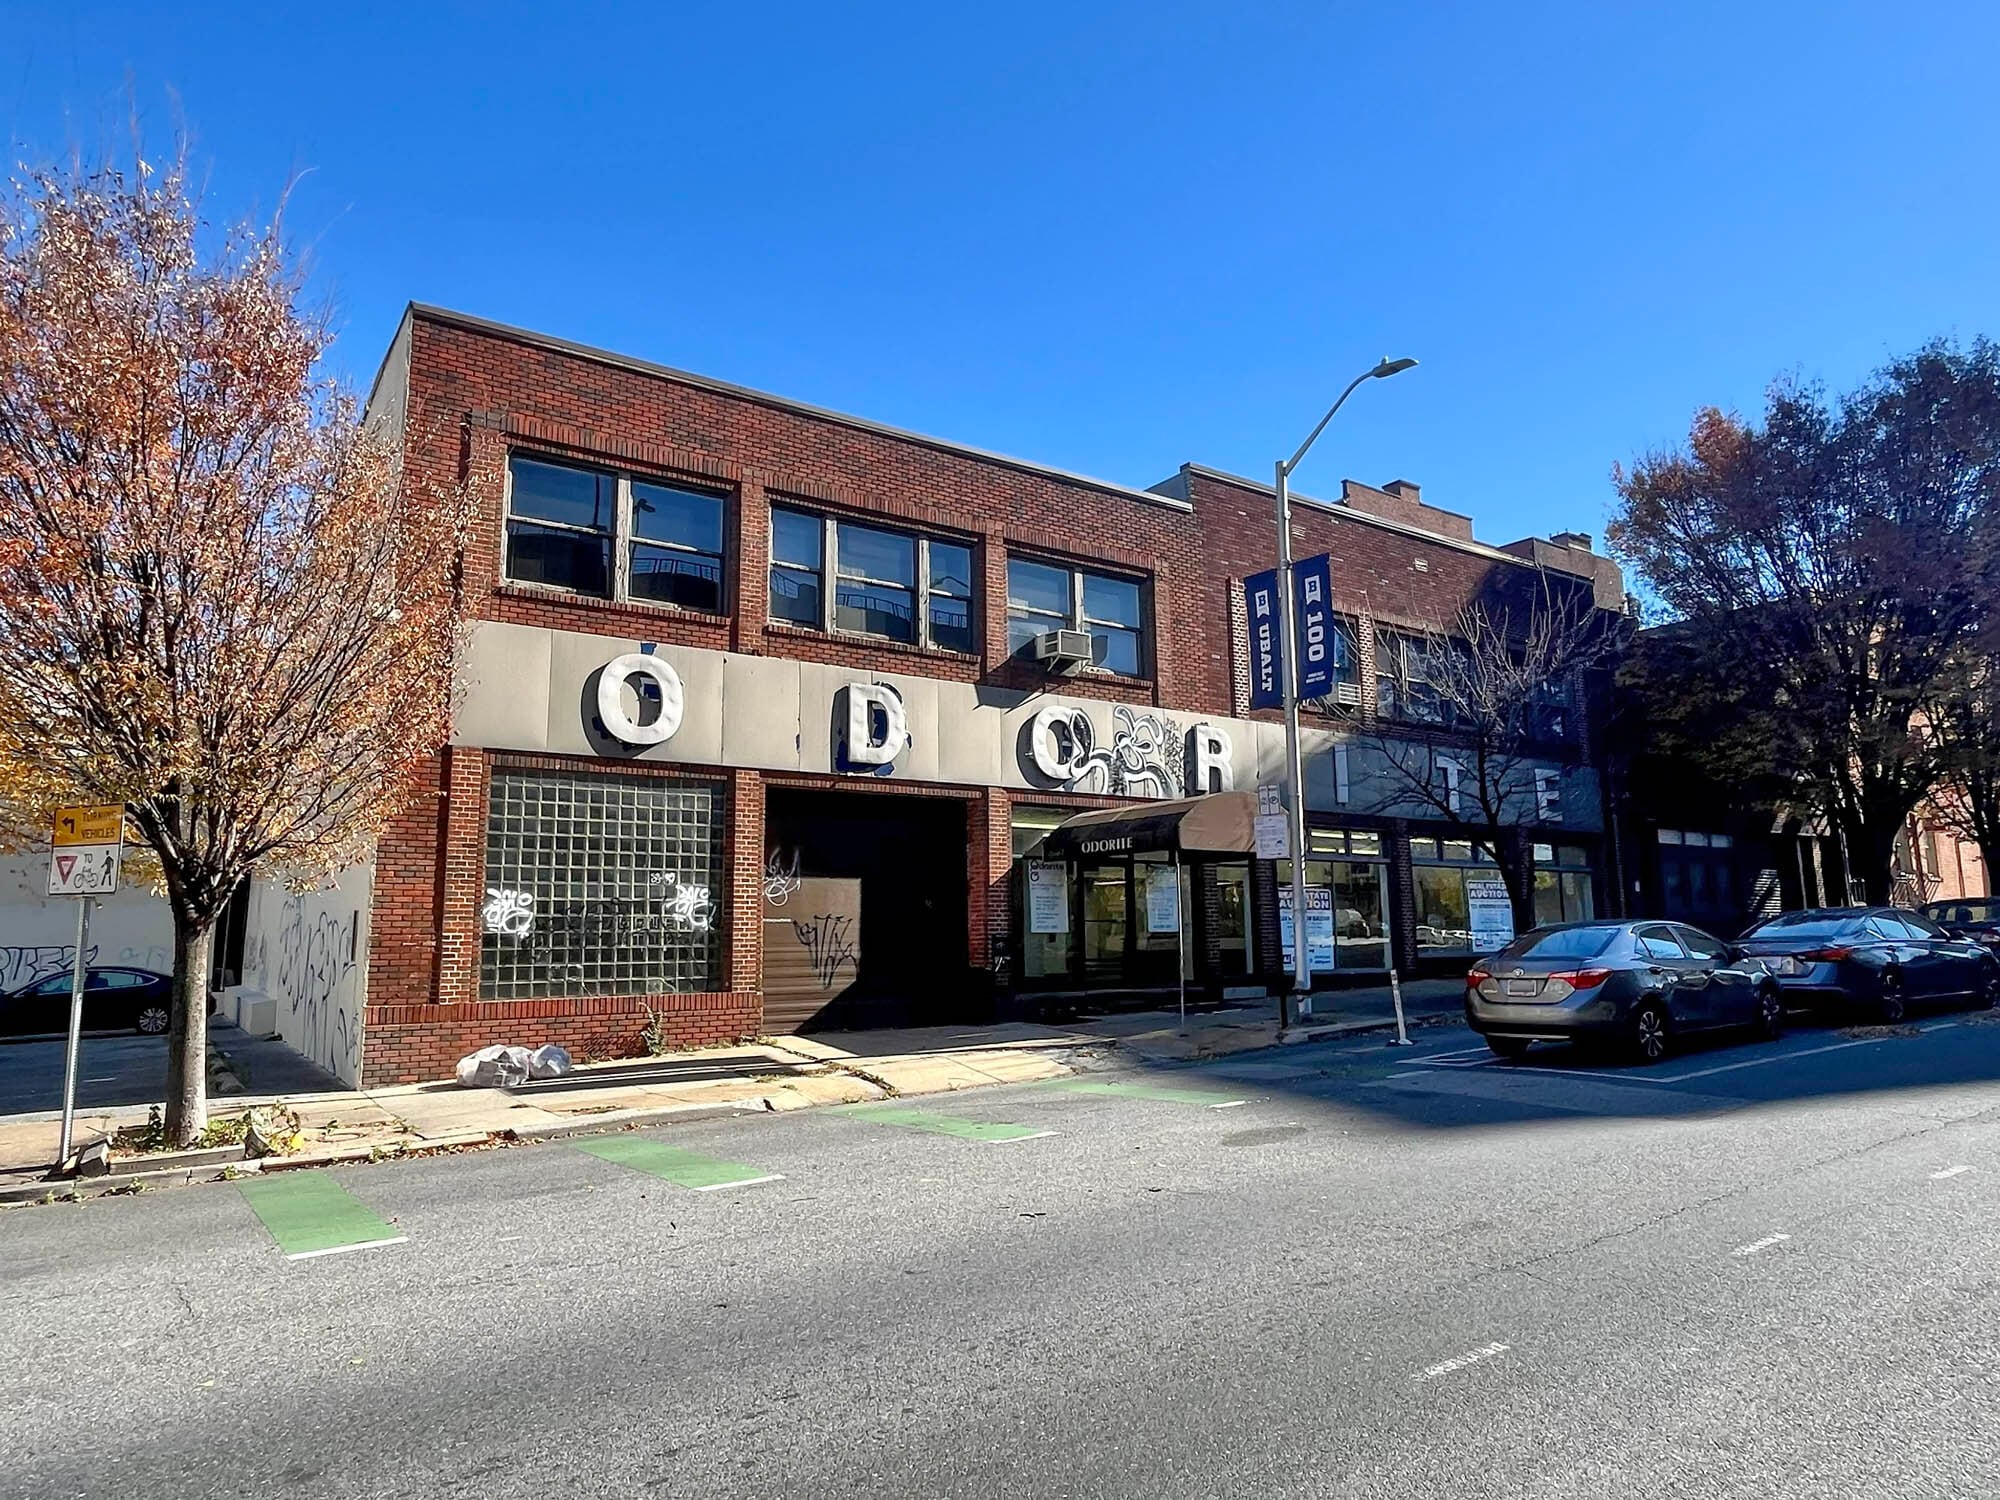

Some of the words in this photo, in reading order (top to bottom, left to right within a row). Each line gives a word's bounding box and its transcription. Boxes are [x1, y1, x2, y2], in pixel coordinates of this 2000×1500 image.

[1307, 611, 1325, 661] 100
[1259, 623, 1273, 692] UBALT
[84, 853, 93, 864] TO
[1081, 837, 1133, 853] ODORITE
